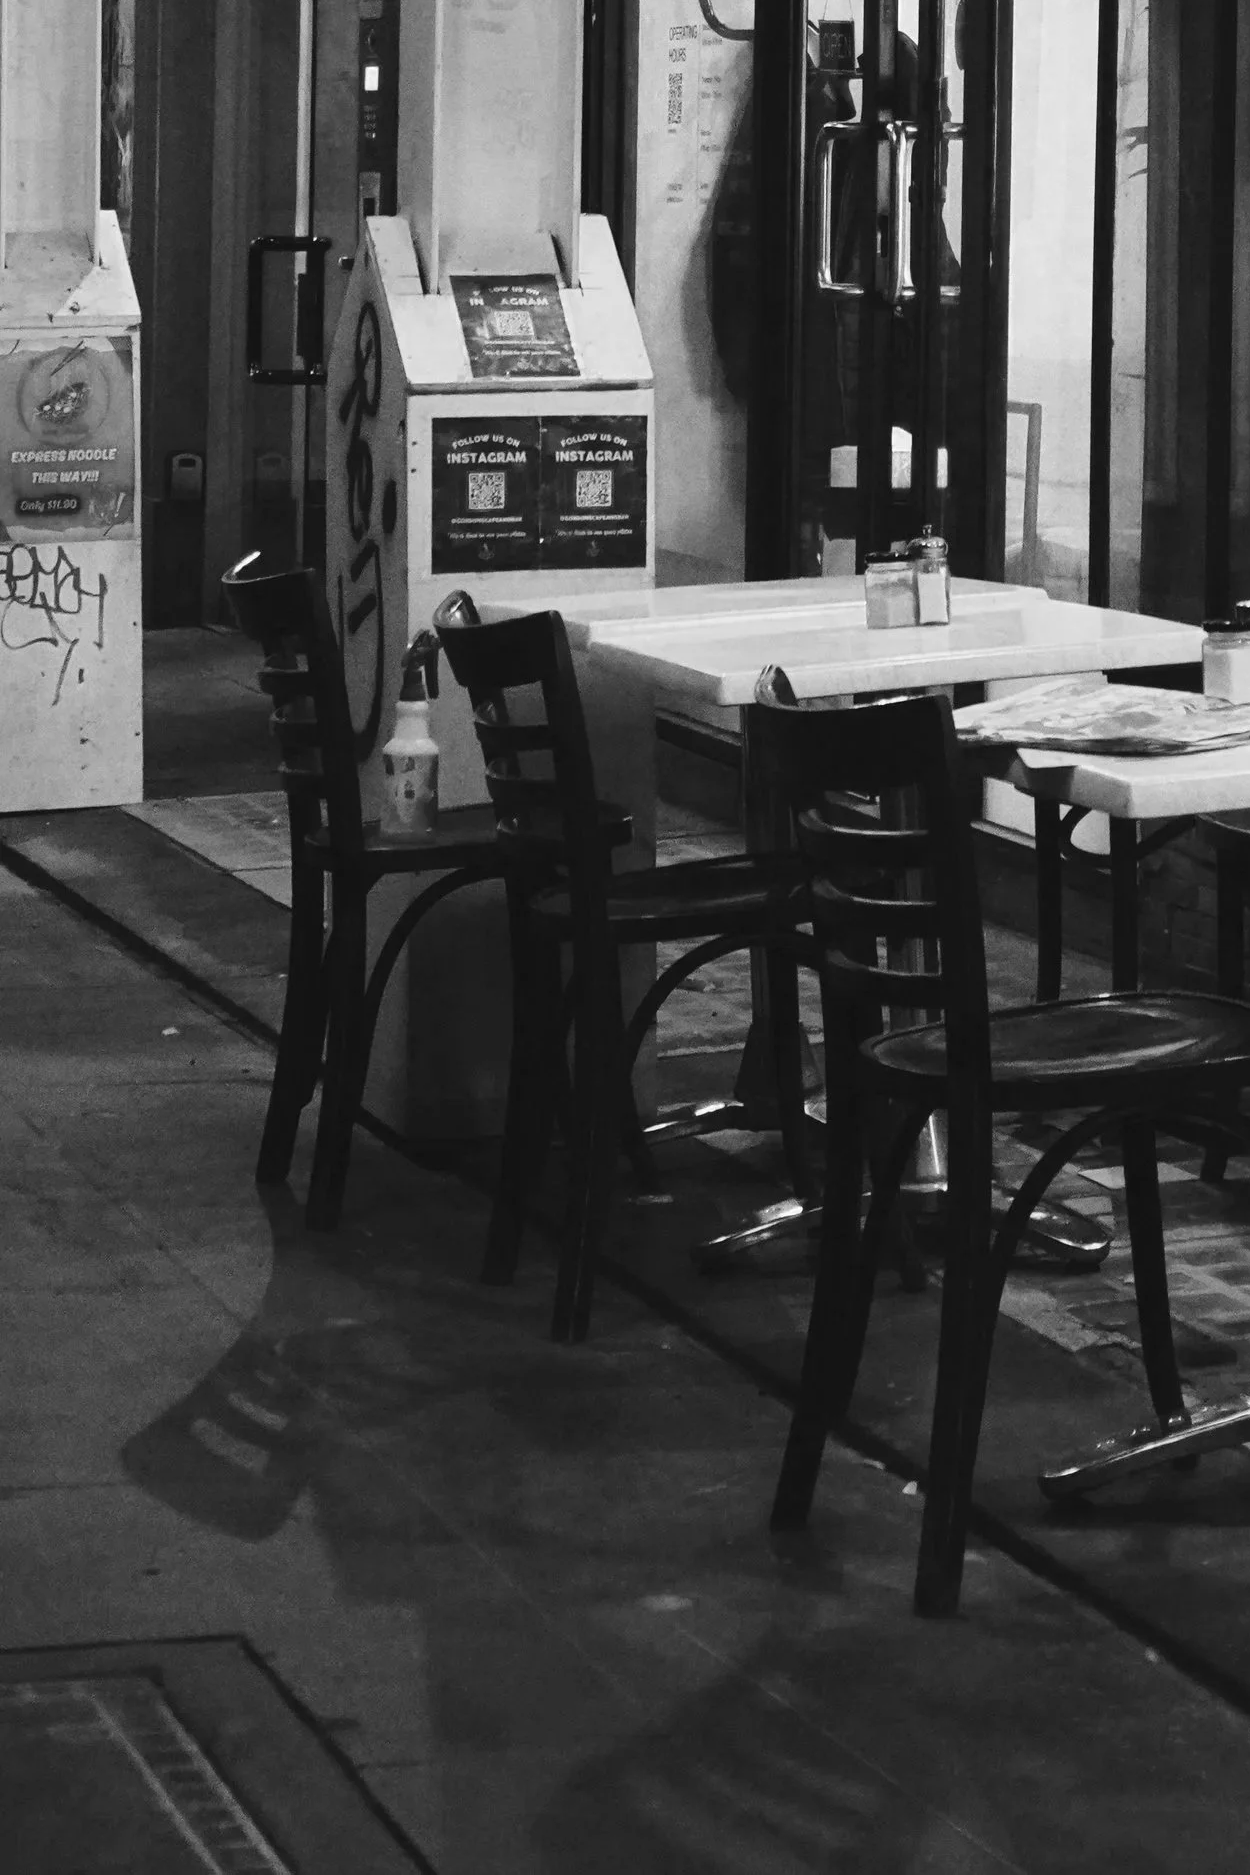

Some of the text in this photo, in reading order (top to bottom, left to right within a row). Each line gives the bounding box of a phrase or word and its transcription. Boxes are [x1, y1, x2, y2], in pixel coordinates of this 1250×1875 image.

[668, 24, 698, 41] OPERATING
[668, 48, 687, 62] HOURS
[452, 434, 521, 450] FOLLOW US ON
[560, 433, 628, 448] FOLLOW US ON
[11, 448, 117, 463] EXPRESS NOODLE
[447, 451, 527, 464] INSTAGRAM
[555, 450, 634, 462] INSTAGRAM
[32, 471, 58, 483] THIS
[20, 500, 45, 512] Only
